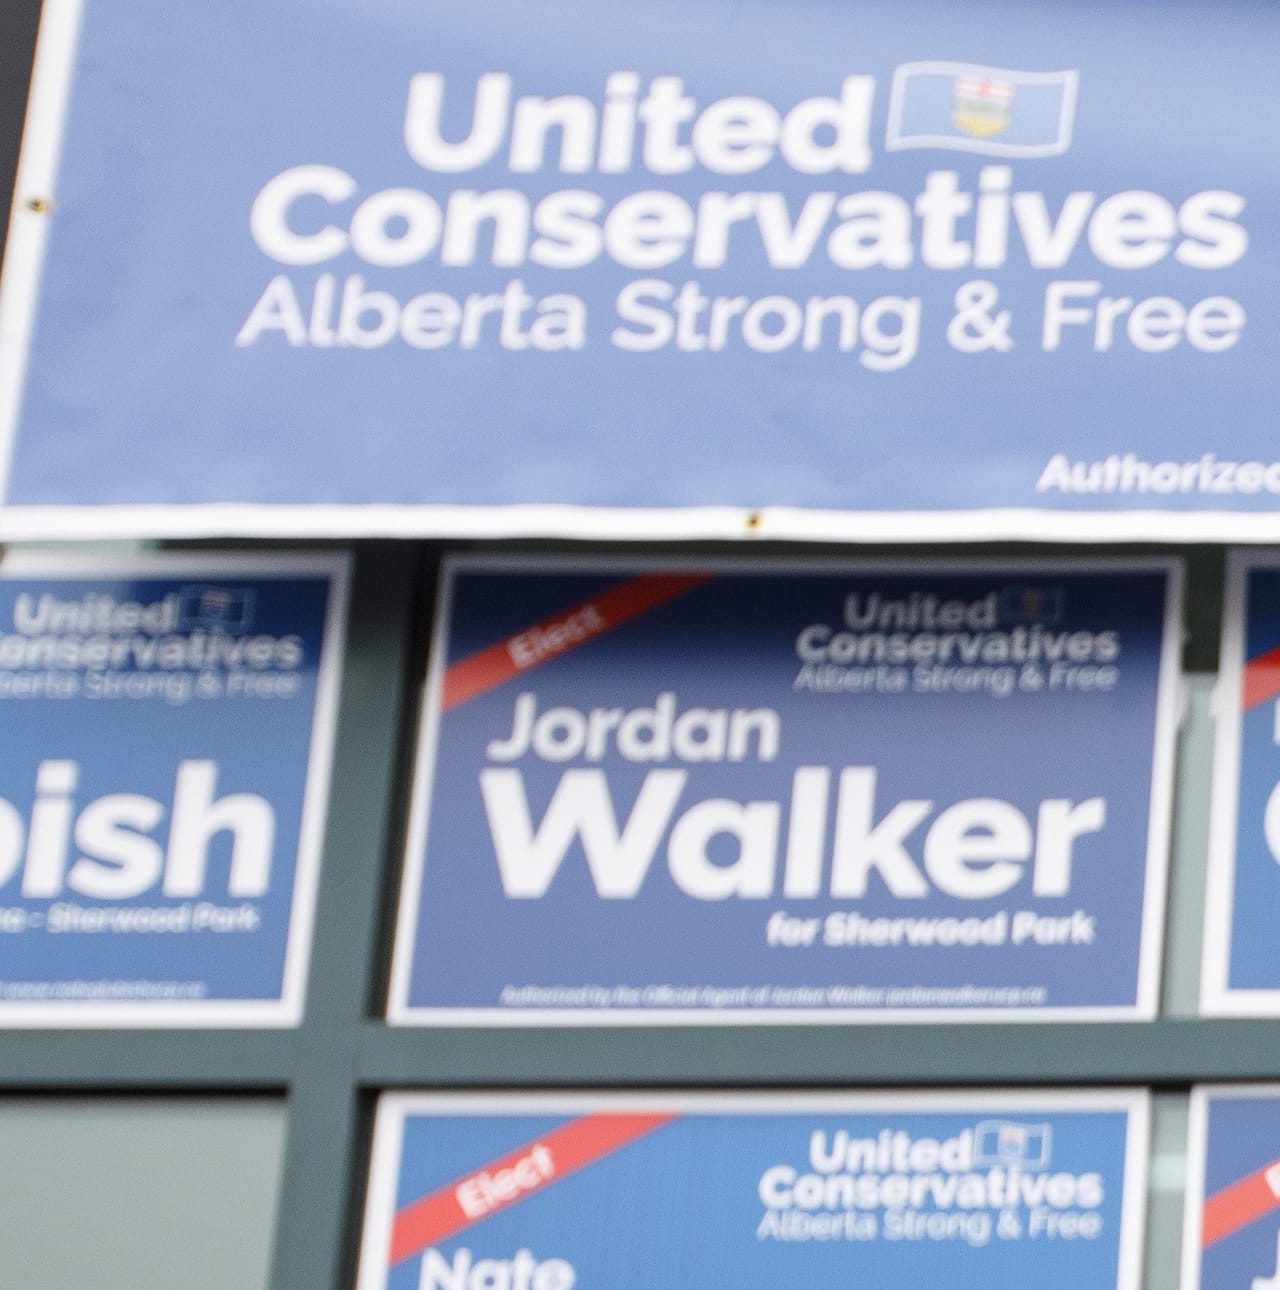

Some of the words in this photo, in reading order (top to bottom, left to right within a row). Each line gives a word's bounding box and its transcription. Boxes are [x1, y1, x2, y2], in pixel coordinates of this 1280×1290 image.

[404, 71, 875, 173] United
[250, 163, 1249, 270] Conservatives
[236, 274, 586, 351] Alberta
[611, 279, 922, 372] Strong
[947, 280, 1013, 353] &
[1042, 282, 1246, 353] Free
[12, 591, 178, 634] United
[844, 594, 998, 630] United
[505, 604, 607, 669] Elect
[796, 627, 1119, 663] Conservatives
[795, 662, 905, 692] Alberta
[914, 663, 1013, 699] Strong
[1021, 663, 1040, 690] &
[1048, 662, 1116, 692] Free
[486, 693, 780, 763] Jordan
[479, 766, 1106, 899] Walker
[192, 902, 259, 932] Park
[766, 911, 819, 947] for
[823, 912, 1007, 946] Sherwood
[1012, 910, 1094, 944] Park
[809, 1129, 973, 1175] United
[456, 1142, 558, 1220] Elect
[758, 1167, 1103, 1212] Conservatives
[757, 1209, 878, 1240] Alberta
[883, 1209, 992, 1247] Strong
[997, 1208, 1022, 1239] &
[1029, 1206, 1102, 1239] Free
